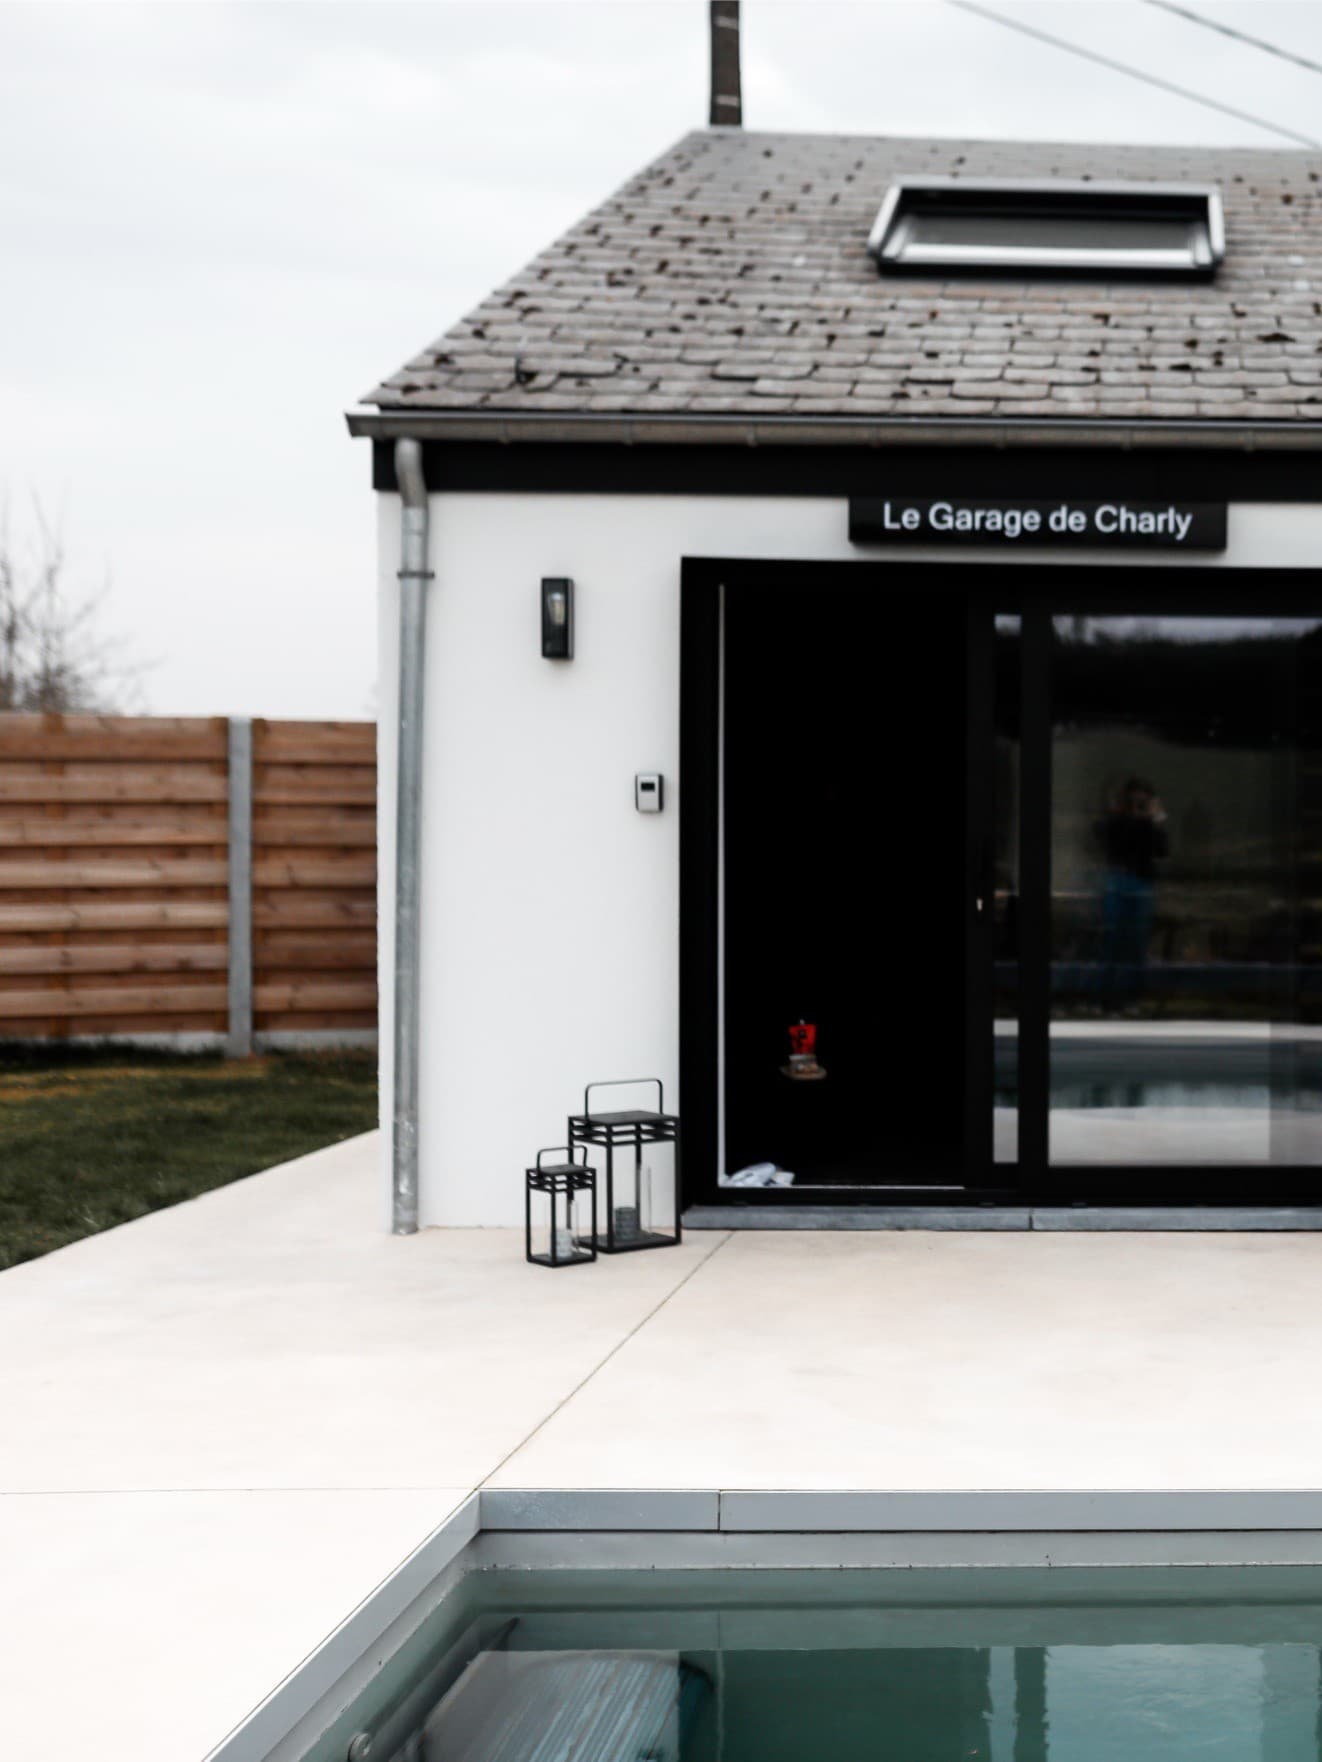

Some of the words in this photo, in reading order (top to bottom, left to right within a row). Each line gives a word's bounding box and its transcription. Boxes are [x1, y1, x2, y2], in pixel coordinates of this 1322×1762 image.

[883, 502, 920, 530] Le
[928, 502, 1041, 537] Garage
[1049, 505, 1087, 532] de
[1094, 505, 1192, 540] Charly
